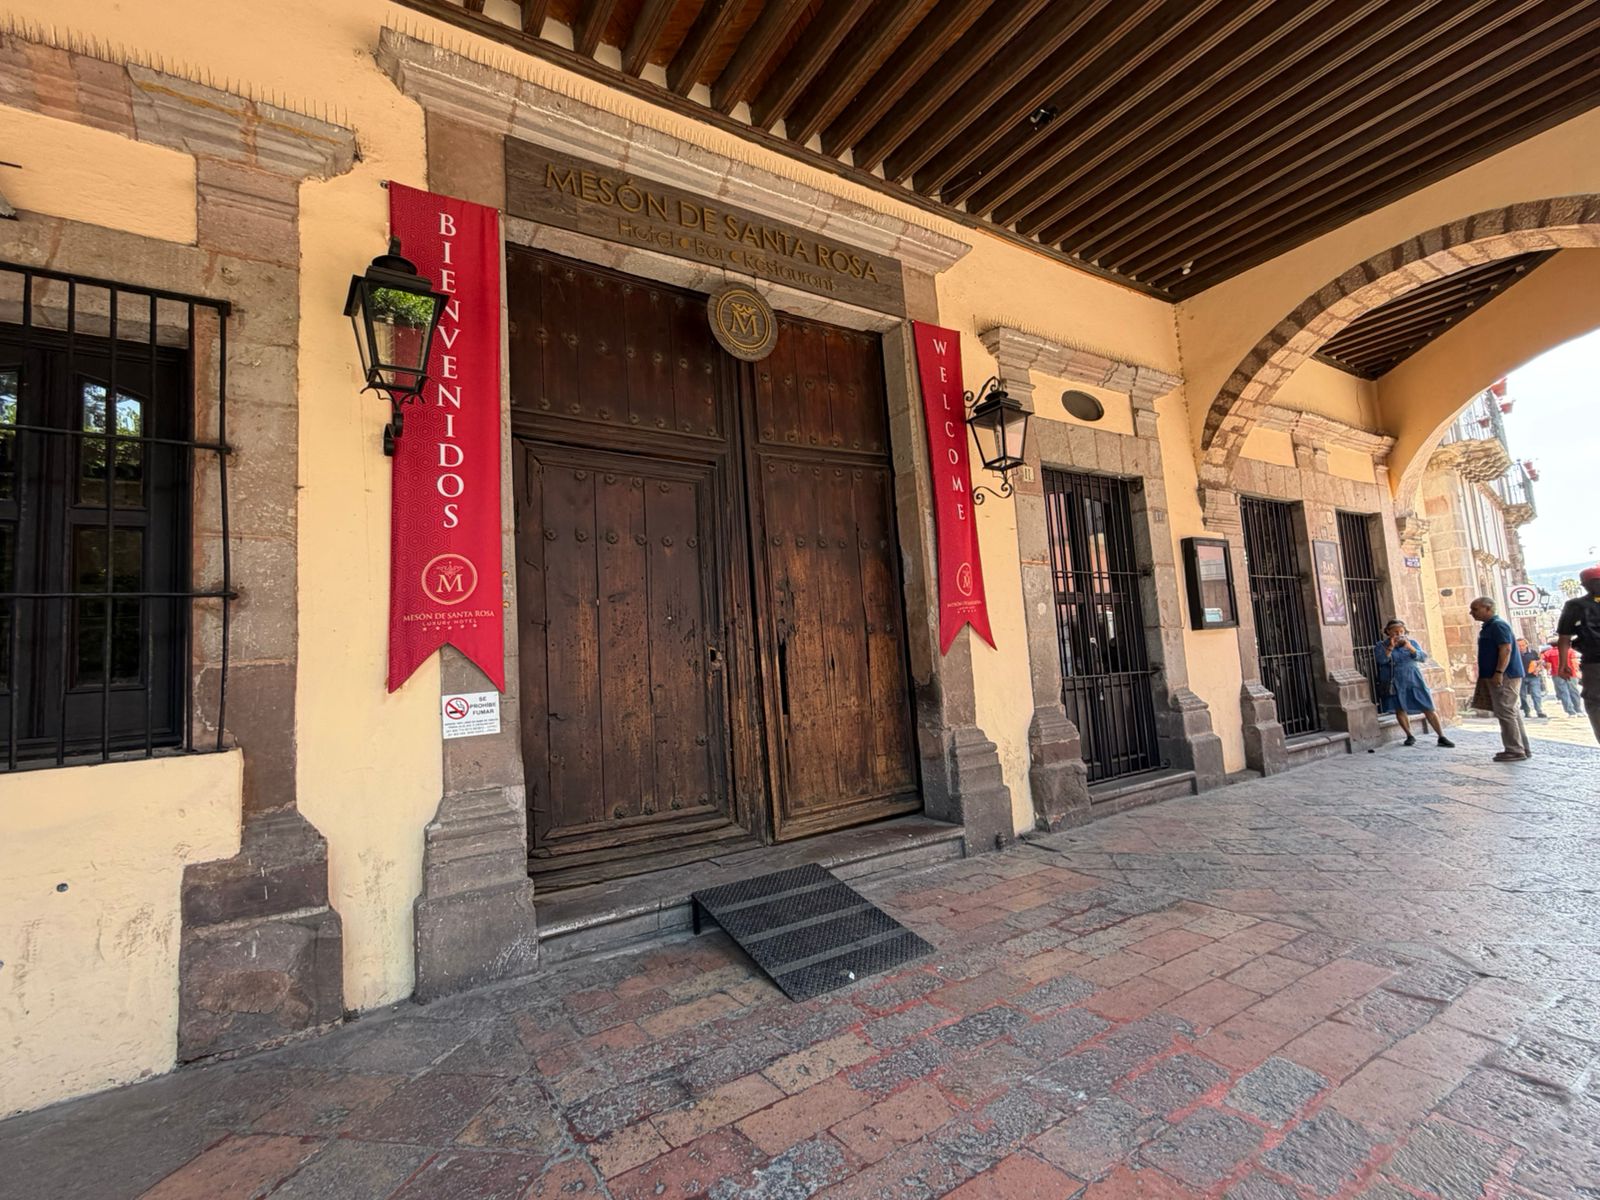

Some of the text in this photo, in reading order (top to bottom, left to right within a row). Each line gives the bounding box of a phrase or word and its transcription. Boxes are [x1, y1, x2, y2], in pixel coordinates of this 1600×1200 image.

[544, 163, 880, 283] MESÓN DE SANTA ROSA
[617, 216, 836, 292] Hotel Bar Restaurant
[437, 212, 464, 528] BIENVENIDOS
[933, 338, 966, 521] WELCOME
[434, 612, 446, 620] DE
[447, 611, 473, 619] SANTA
[436, 573, 464, 593] M
[1517, 590, 1529, 602] E
